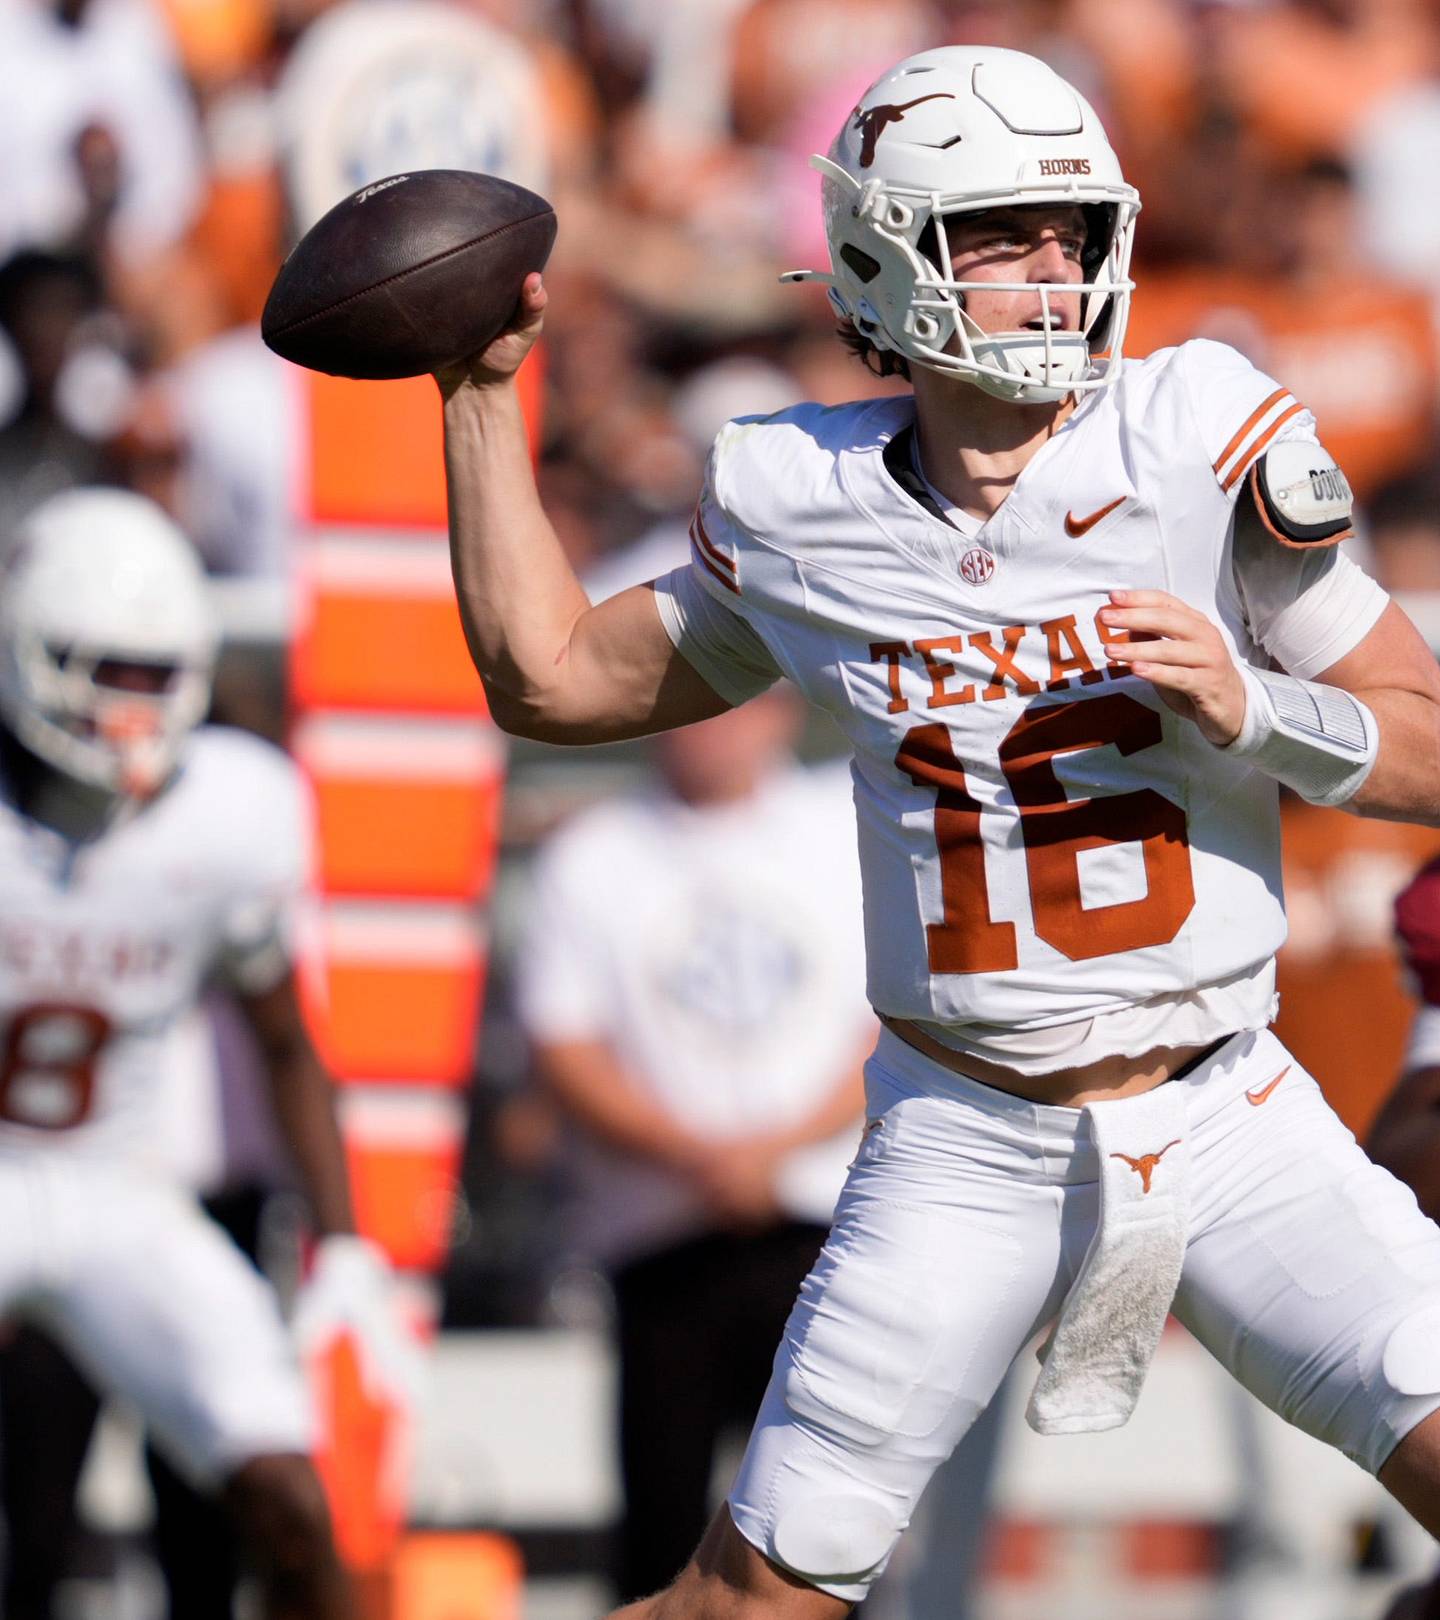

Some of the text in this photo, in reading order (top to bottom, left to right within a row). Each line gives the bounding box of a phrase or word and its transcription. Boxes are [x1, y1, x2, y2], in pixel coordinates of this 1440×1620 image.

[1038, 158, 1092, 176] HORNS
[355, 175, 411, 204] Texas
[960, 549, 995, 584] SEC
[894, 691, 1197, 974] 16
